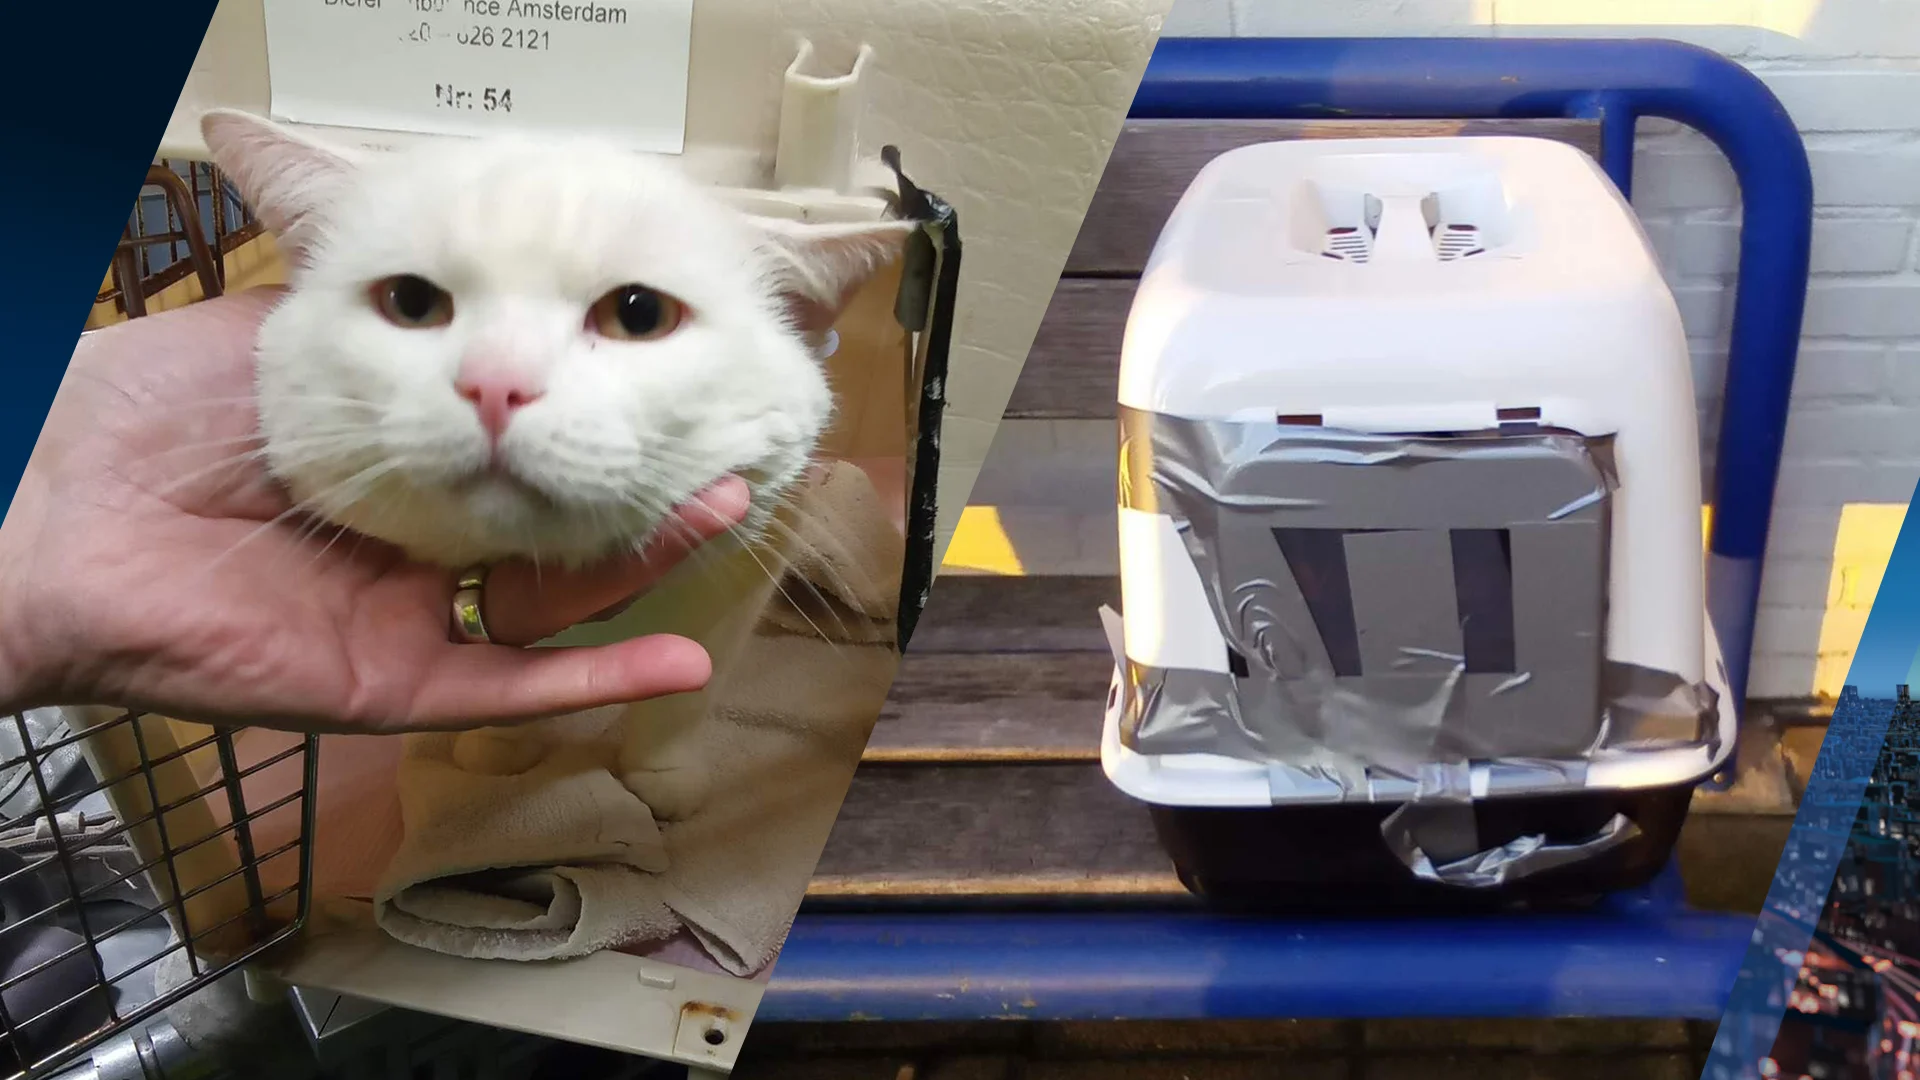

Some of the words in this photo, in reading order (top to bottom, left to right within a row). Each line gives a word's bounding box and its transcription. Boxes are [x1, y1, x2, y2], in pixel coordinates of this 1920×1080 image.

[507, 0, 627, 24] Amsterdam
[501, 27, 550, 50] 2121
[483, 87, 512, 113] 54
